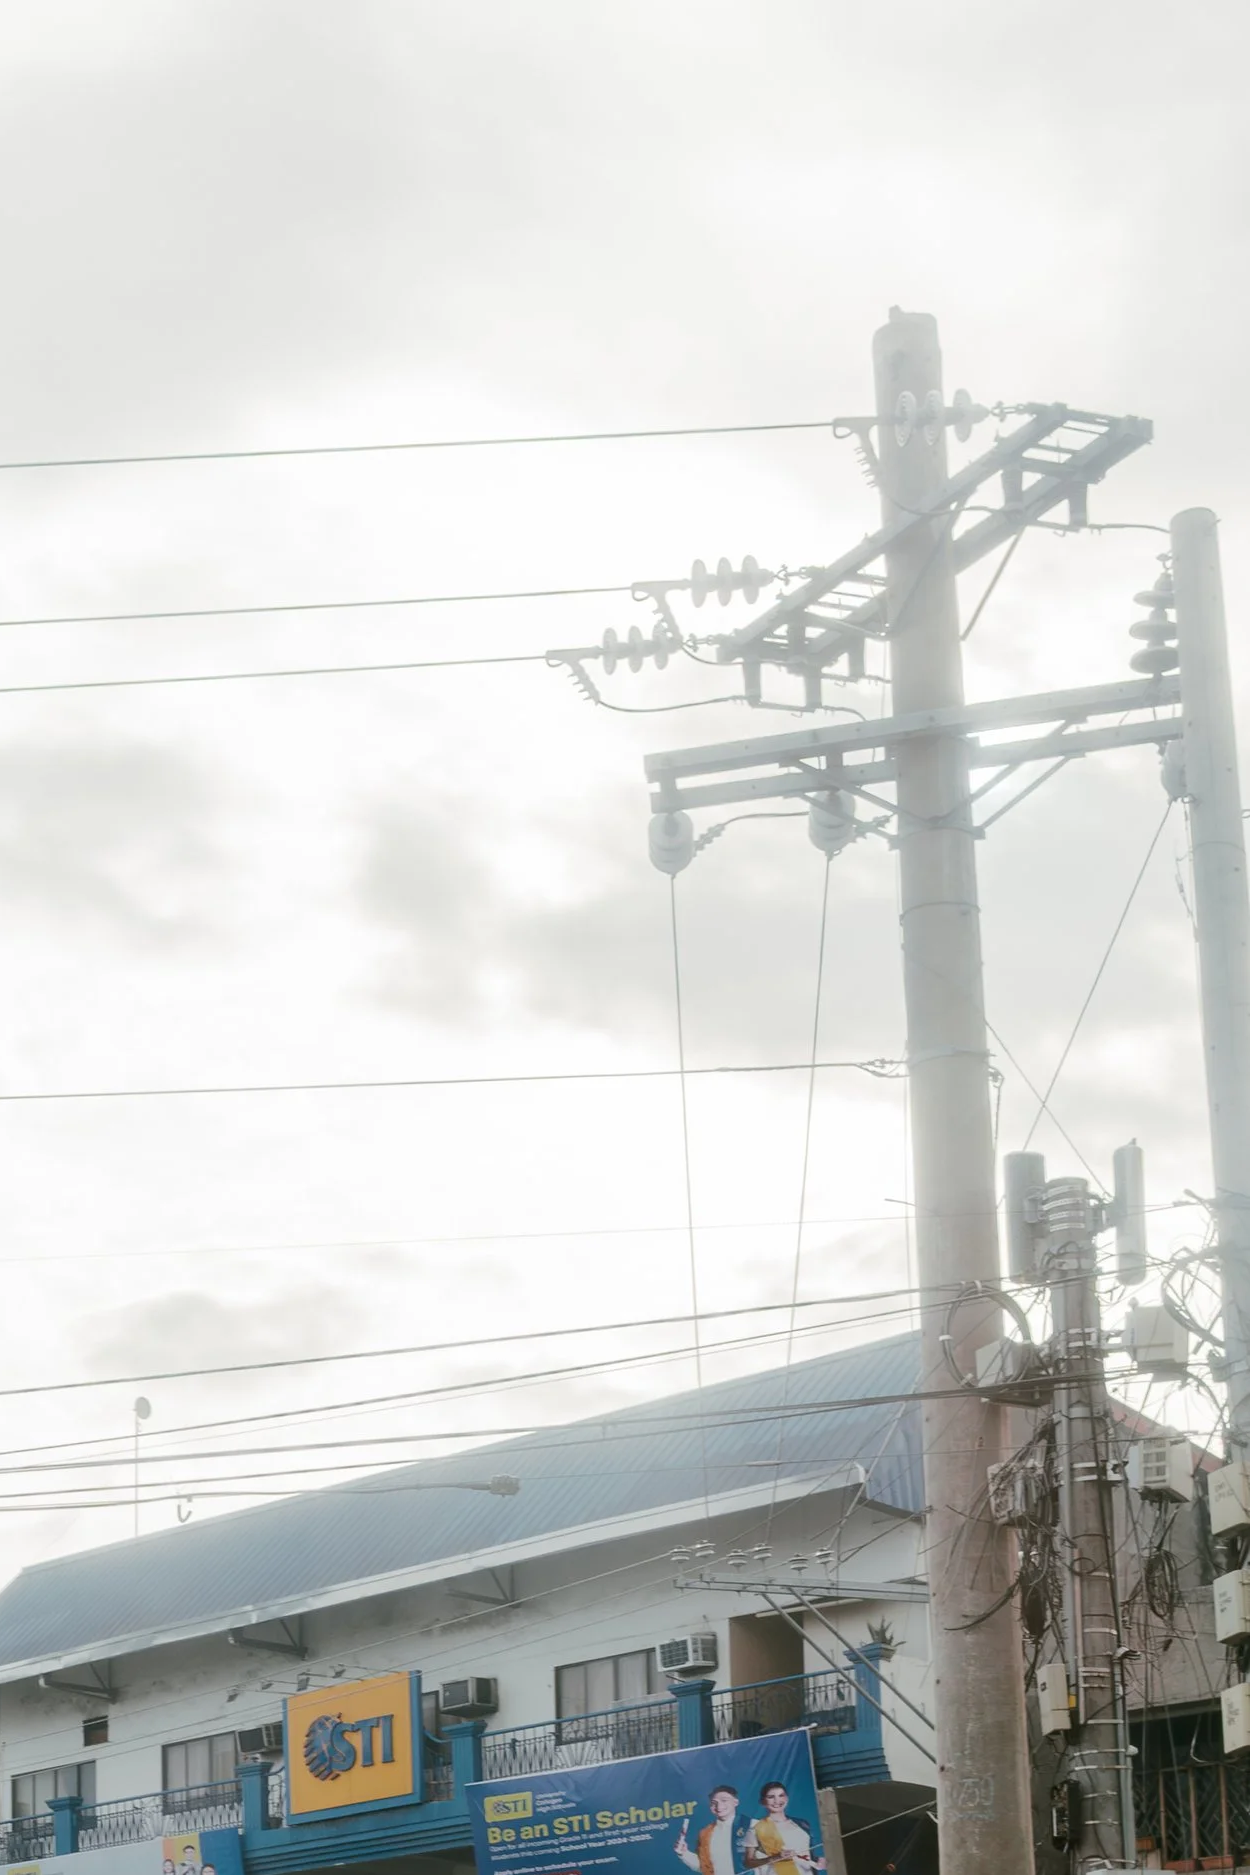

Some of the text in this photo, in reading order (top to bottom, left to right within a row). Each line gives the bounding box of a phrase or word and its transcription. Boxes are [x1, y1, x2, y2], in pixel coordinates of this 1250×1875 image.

[331, 1713, 395, 1772] STI
[487, 1801, 698, 1844] Be an STI Scholar
[489, 1845, 506, 1853] Open
[527, 1838, 558, 1848] incoming
[640, 1822, 668, 1832] college
[491, 1852, 519, 1861] students
[534, 1846, 559, 1856] coming
[560, 1843, 586, 1851] School
[513, 1866, 534, 1874] online
[543, 1861, 576, 1870] schedule
[577, 1858, 593, 1866] your
